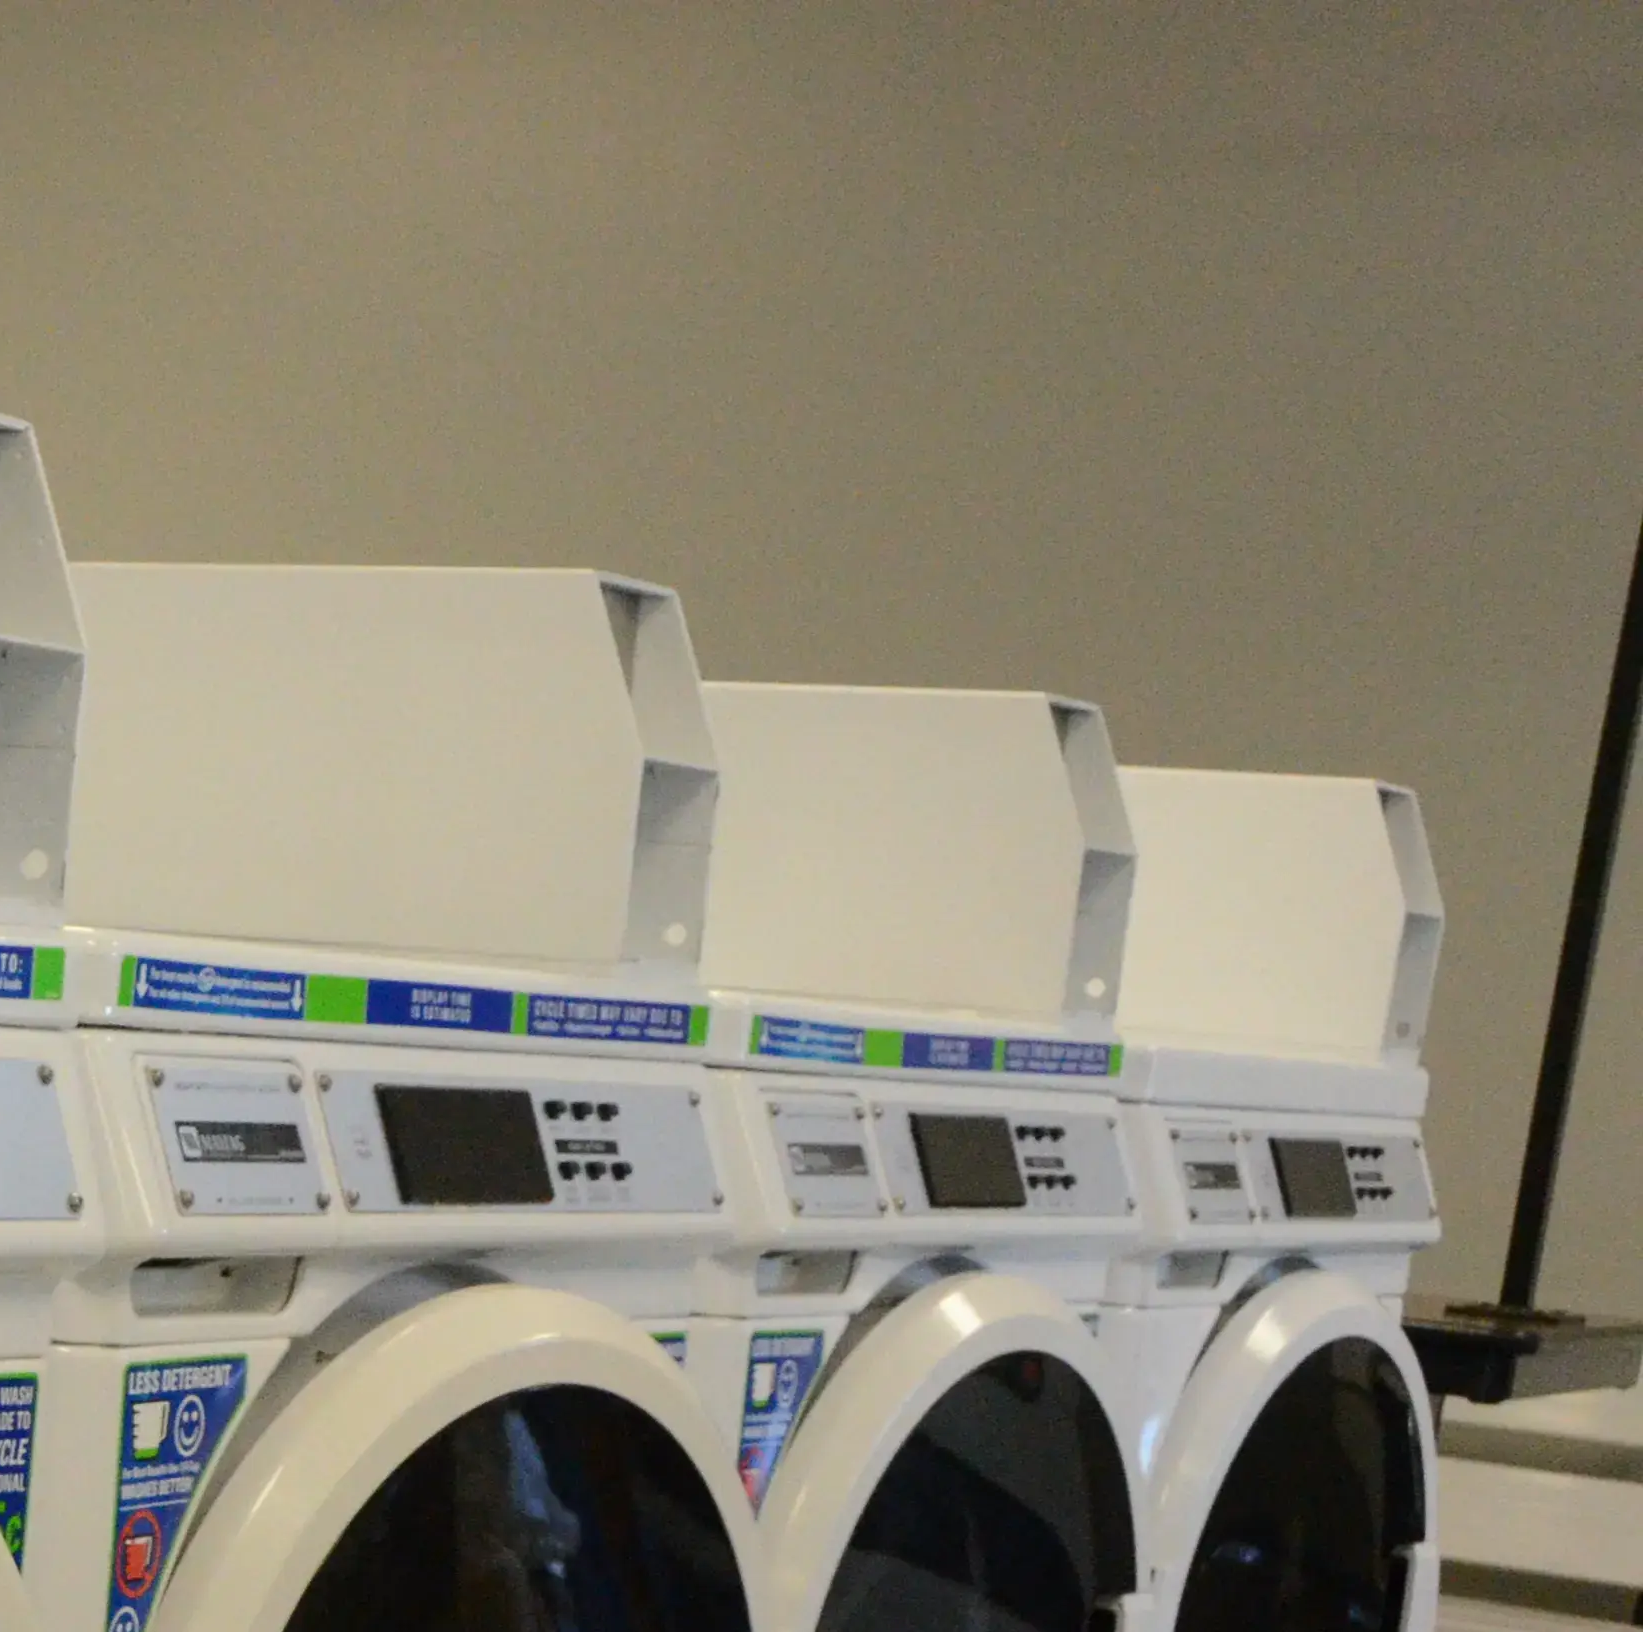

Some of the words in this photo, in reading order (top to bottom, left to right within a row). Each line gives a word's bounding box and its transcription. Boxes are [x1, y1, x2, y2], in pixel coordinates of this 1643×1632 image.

[128, 1370, 159, 1395] LESS
[162, 1364, 232, 1392] DETERGENT
[0, 1385, 34, 1406] WASH
[16, 1410, 32, 1430] TO
